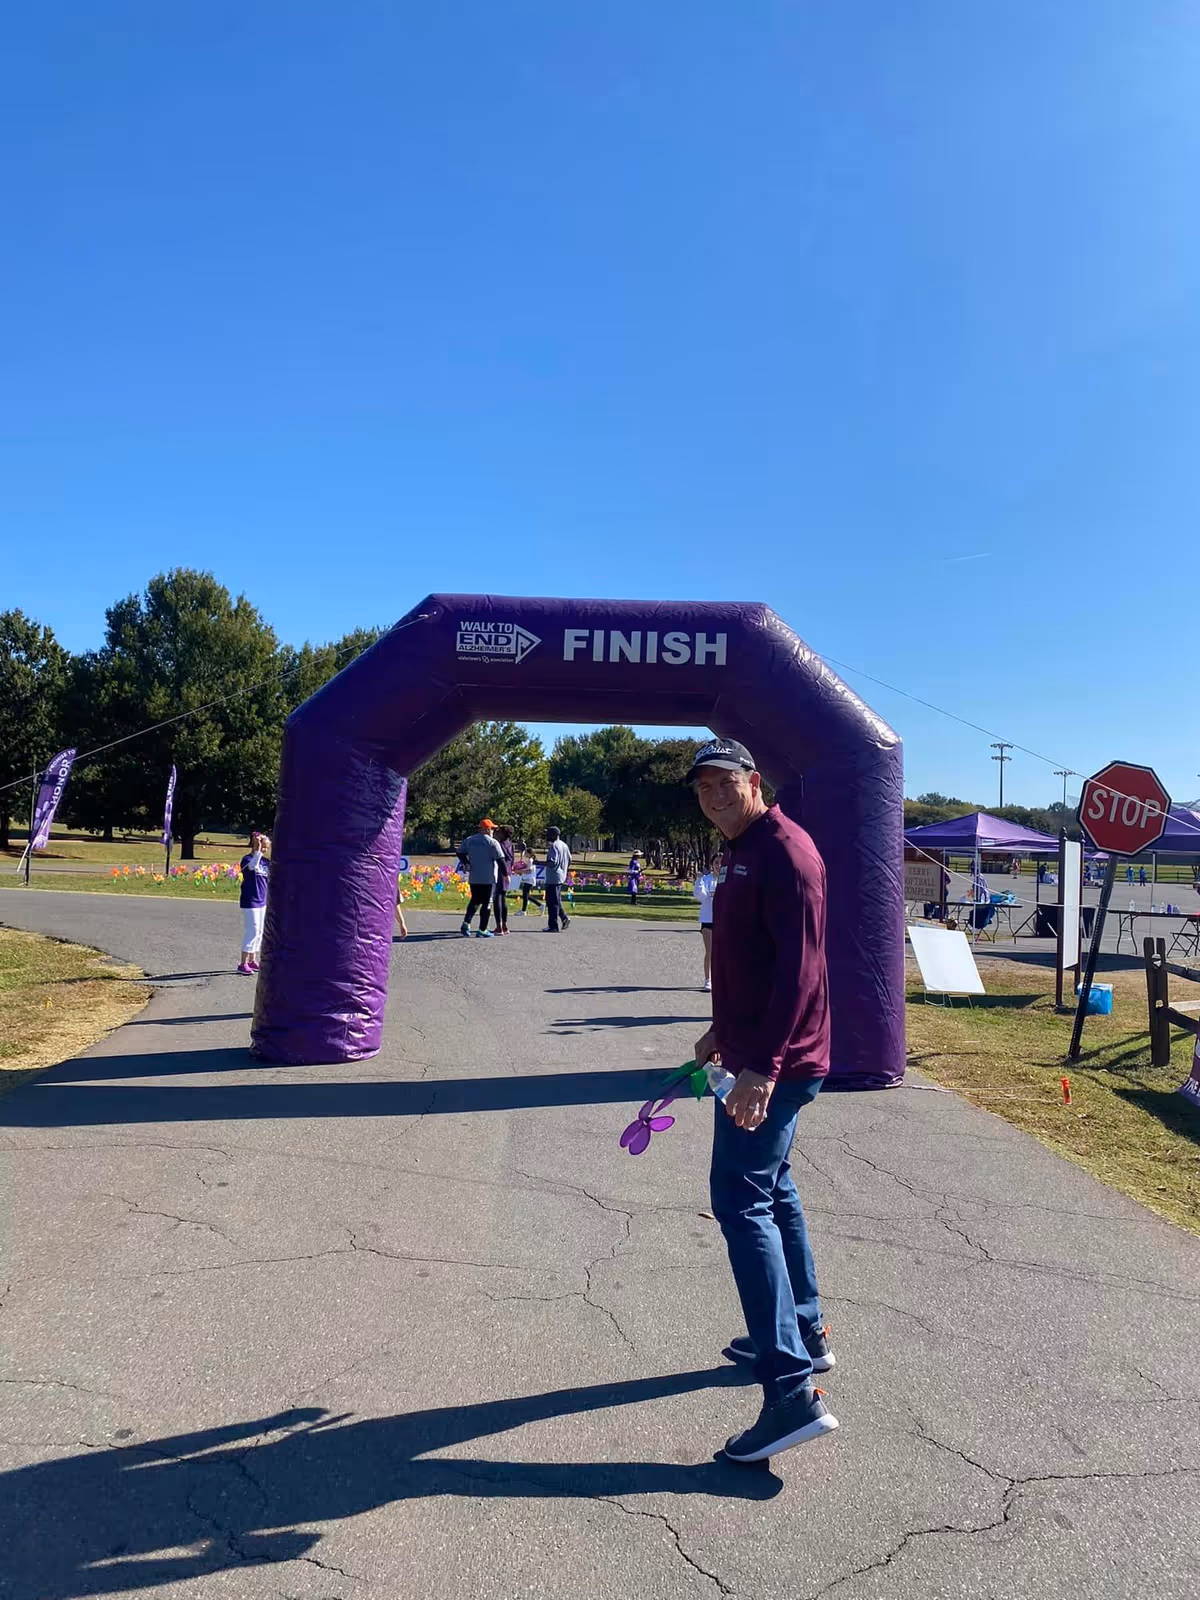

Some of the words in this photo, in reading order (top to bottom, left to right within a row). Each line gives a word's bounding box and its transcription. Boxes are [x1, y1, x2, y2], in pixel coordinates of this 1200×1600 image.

[460, 621, 495, 632] WALK
[497, 622, 513, 633] TO
[458, 644, 512, 653] ALZHEIMER'S
[459, 633, 512, 646] END
[563, 629, 728, 665] FINISH
[49, 752, 67, 772] PROMISE
[67, 749, 76, 757] TO
[50, 759, 71, 804] HONOR
[1088, 788, 1161, 828] STOP
[536, 866, 545, 879] Z
